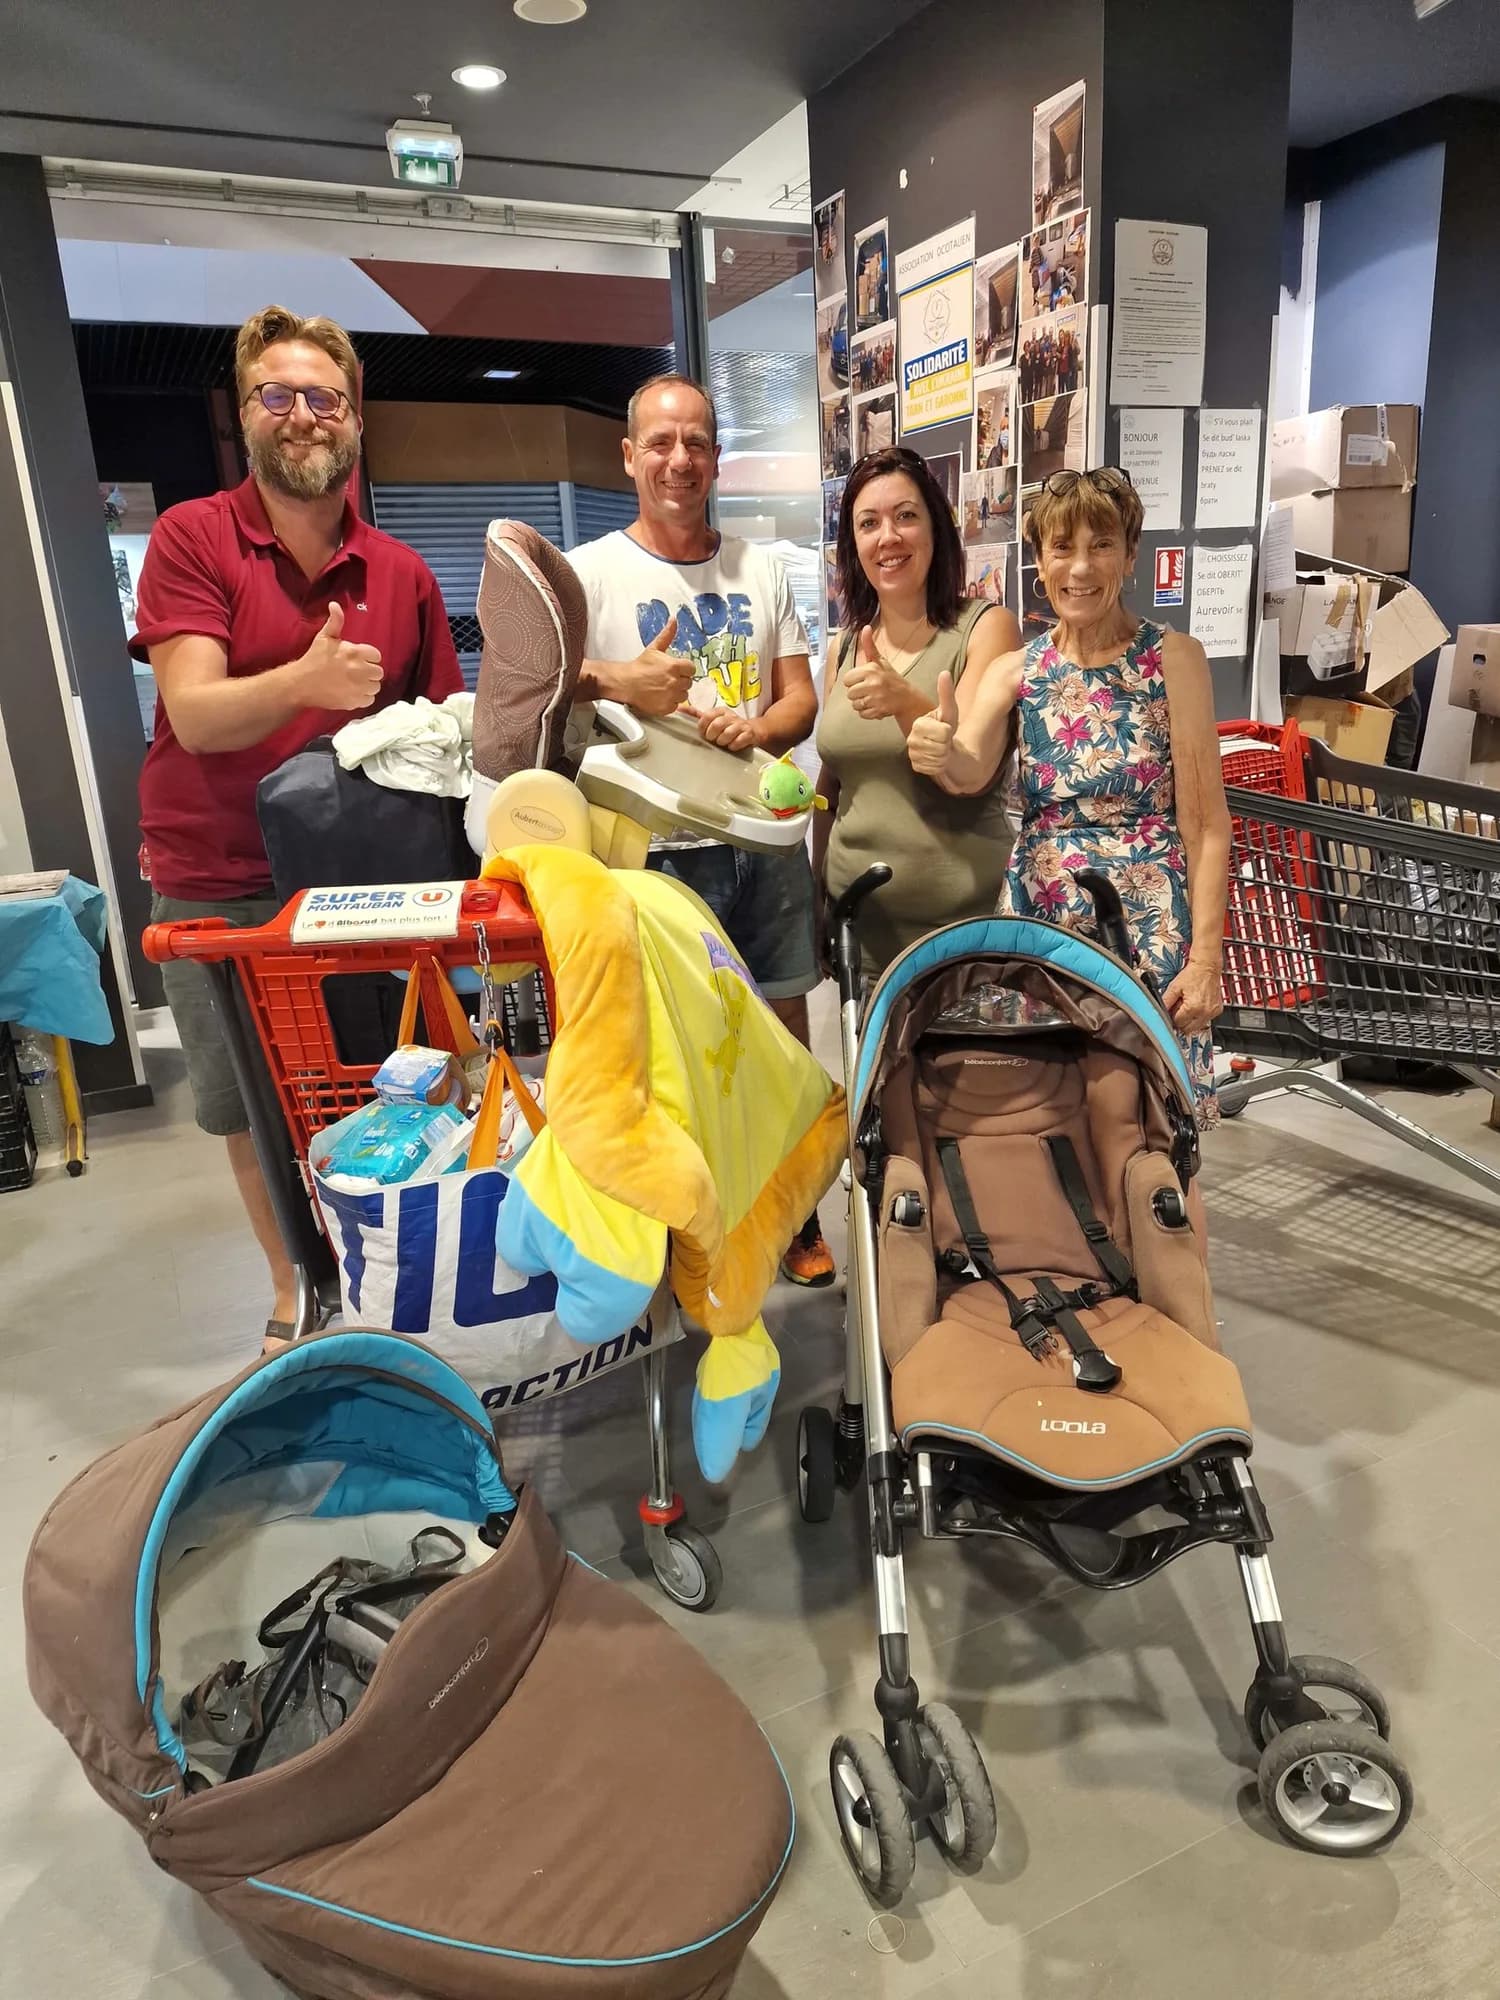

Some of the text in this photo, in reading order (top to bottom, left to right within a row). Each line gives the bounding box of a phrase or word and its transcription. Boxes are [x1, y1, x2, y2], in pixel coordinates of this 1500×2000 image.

[898, 249, 934, 275] ASSOCIATION
[906, 341, 966, 382] SOLIDARITÉ
[1123, 433, 1158, 442] BONJOUR
[1201, 465, 1225, 473] PRENEZ
[1132, 476, 1159, 485] NVENUE
[1207, 571, 1216, 579] dit
[1195, 604, 1234, 616] Aurevoir
[1194, 624, 1214, 632] dit do
[310, 891, 444, 904] SUPER U
[306, 901, 404, 912] MONTAUBAN
[380, 917, 398, 925] bat
[399, 915, 421, 925] plus
[423, 914, 441, 923] fort
[481, 1314, 654, 1409] ACTION
